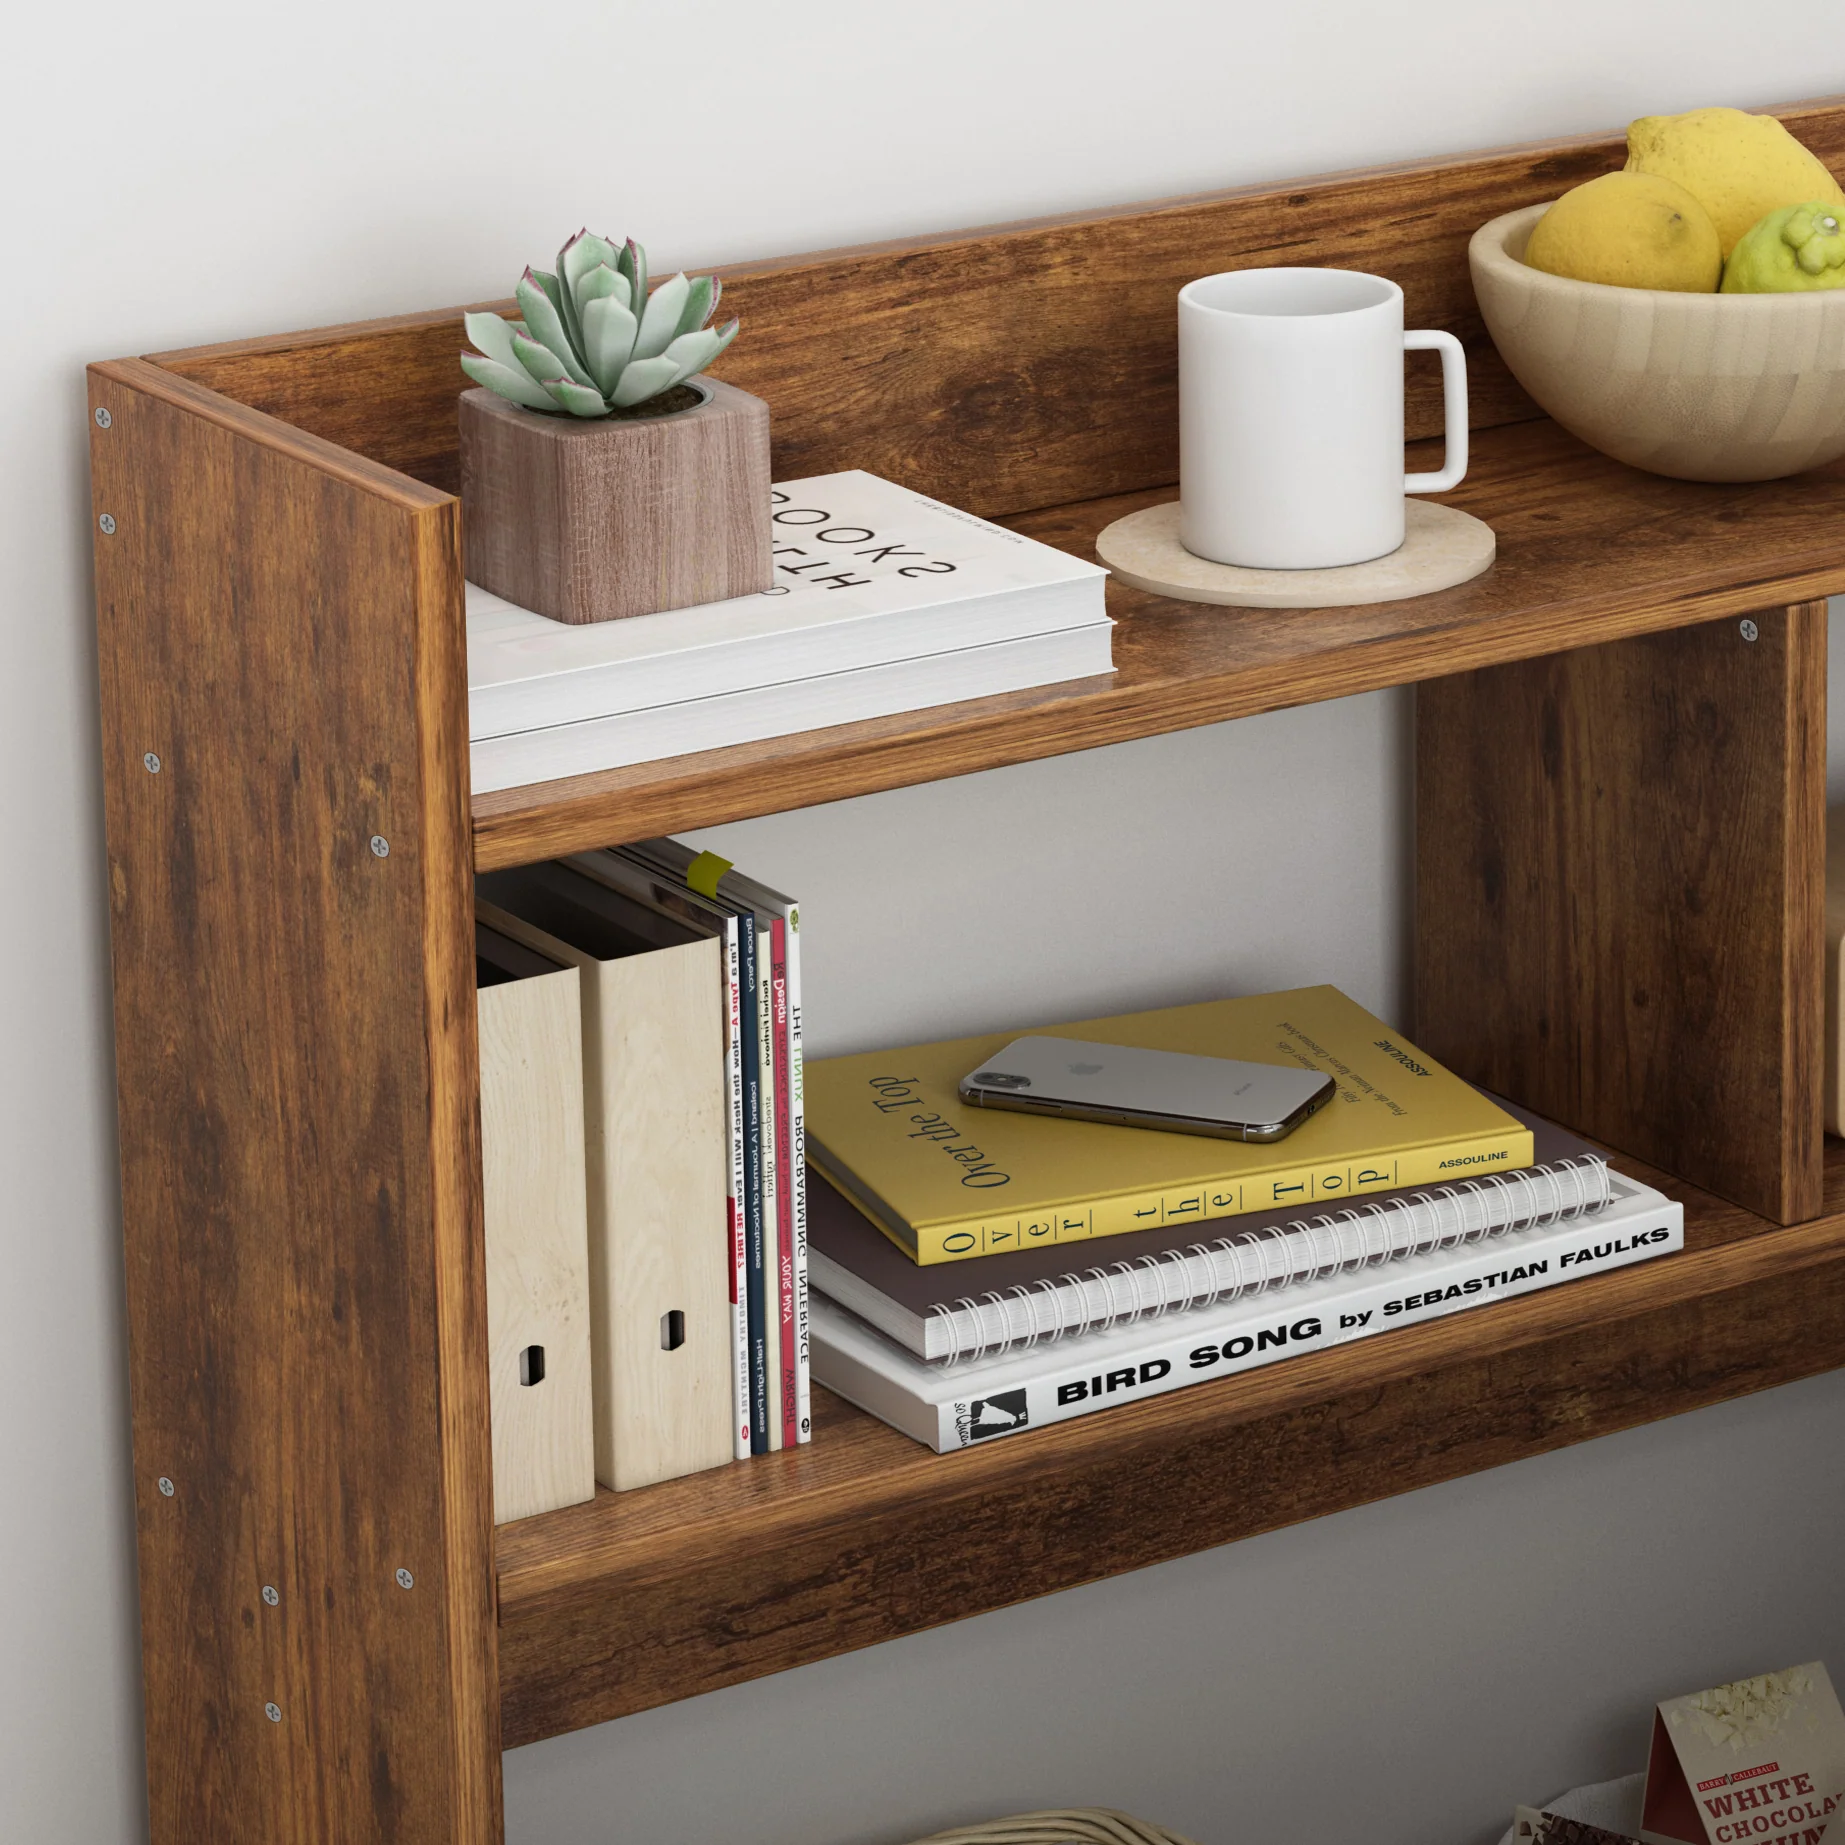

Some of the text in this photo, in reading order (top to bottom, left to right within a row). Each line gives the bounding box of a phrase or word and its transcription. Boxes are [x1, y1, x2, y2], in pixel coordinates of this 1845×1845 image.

[1373, 1040, 1433, 1077] ASSOULINE
[868, 1077, 1010, 1188] Over the Top
[1438, 1151, 1508, 1169] ASSOULINE
[1057, 1227, 1669, 1406] BIRD SONG by SEBASTIAN FAULKS
[1699, 1763, 1778, 1791] BARRY CALLEBAUT
[1703, 1773, 1815, 1819] WHITE
[1716, 1793, 1842, 1843] CHOCOLA
